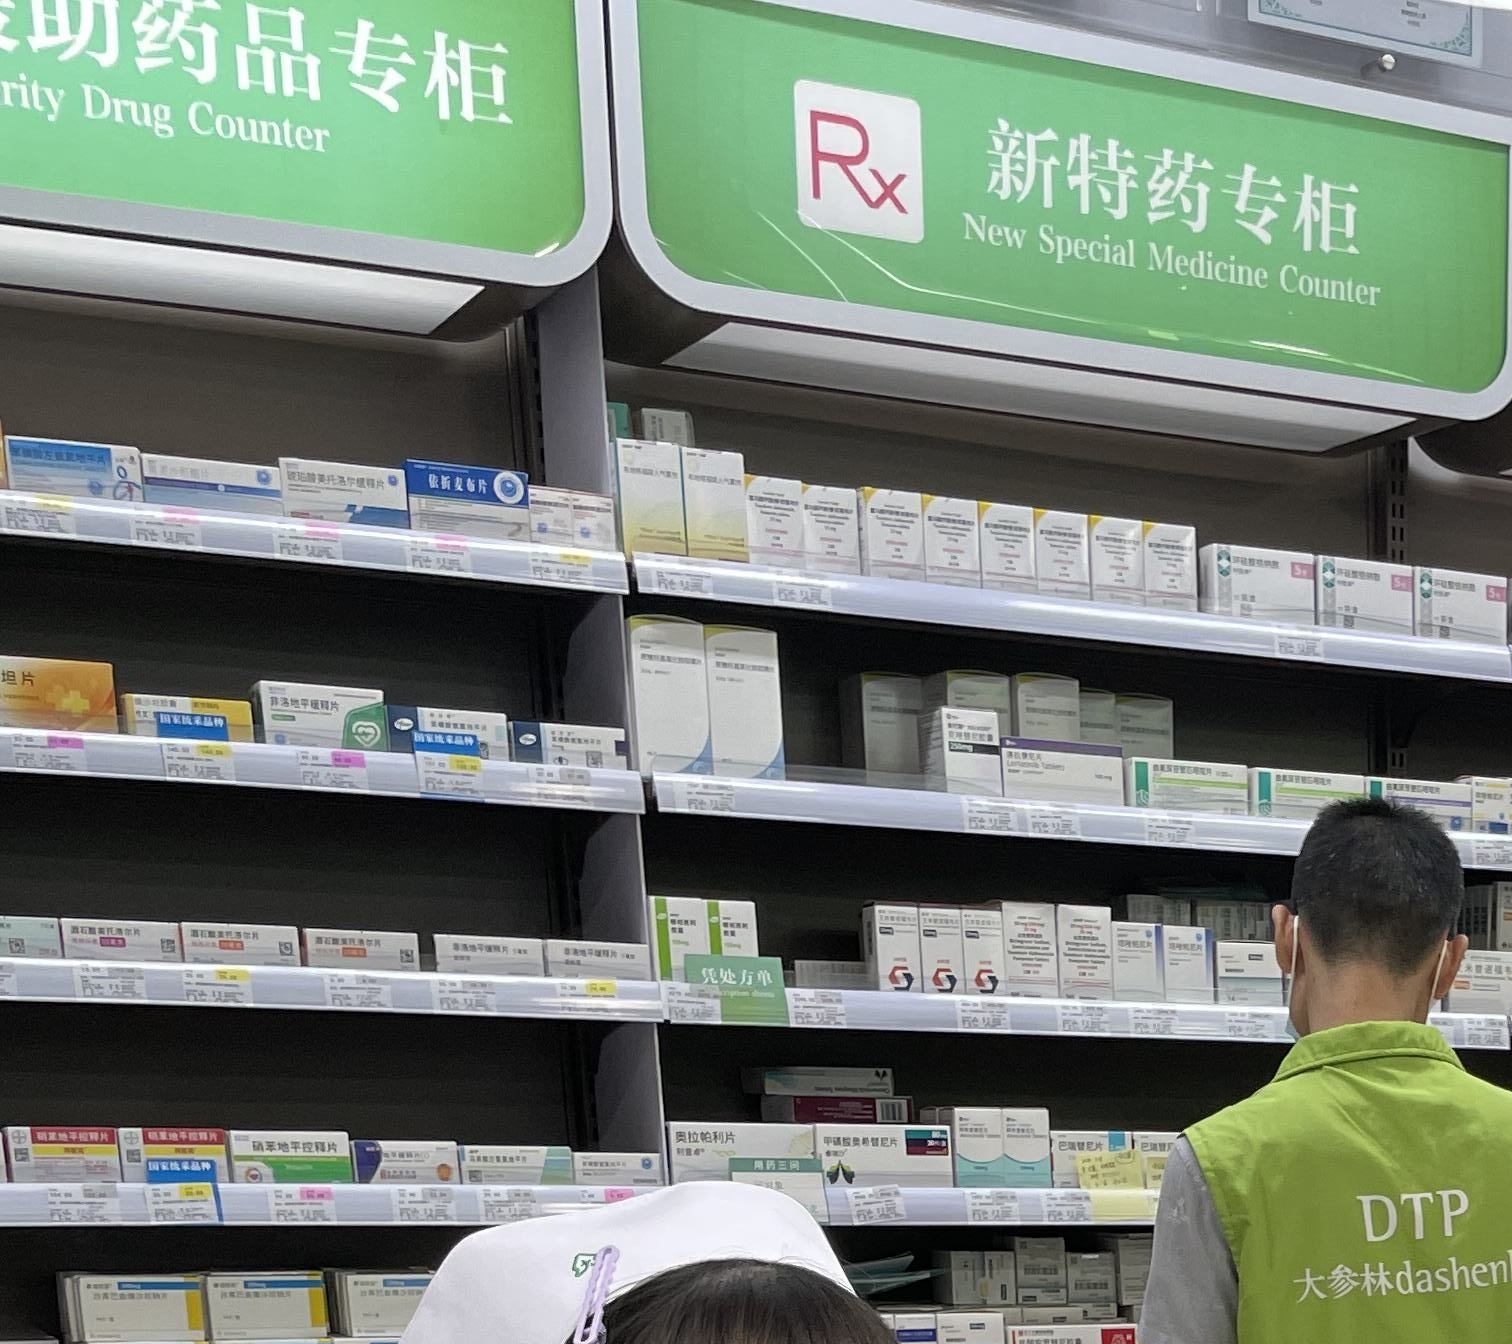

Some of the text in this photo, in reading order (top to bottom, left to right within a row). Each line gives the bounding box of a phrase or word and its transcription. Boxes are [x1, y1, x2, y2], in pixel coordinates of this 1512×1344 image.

[0, 0, 513, 126] 助药品专柜
[82, 83, 174, 139] Drug
[188, 101, 331, 153] Counter
[808, 109, 908, 215] Rx
[985, 118, 1362, 256] 新特药专柜
[962, 212, 1382, 307] New Special Medicine Counter
[427, 472, 488, 495] 依折麦布片
[700, 967, 774, 987] 凭处方单
[251, 1140, 338, 1155] 硝苯地平控释片
[675, 1131, 737, 1146] 奥拉帕利片
[823, 1135, 898, 1149] 甲磺酸奥希替尼片
[1058, 1140, 1104, 1152] 巴瑞替尼片
[1356, 1189, 1469, 1243] DTP
